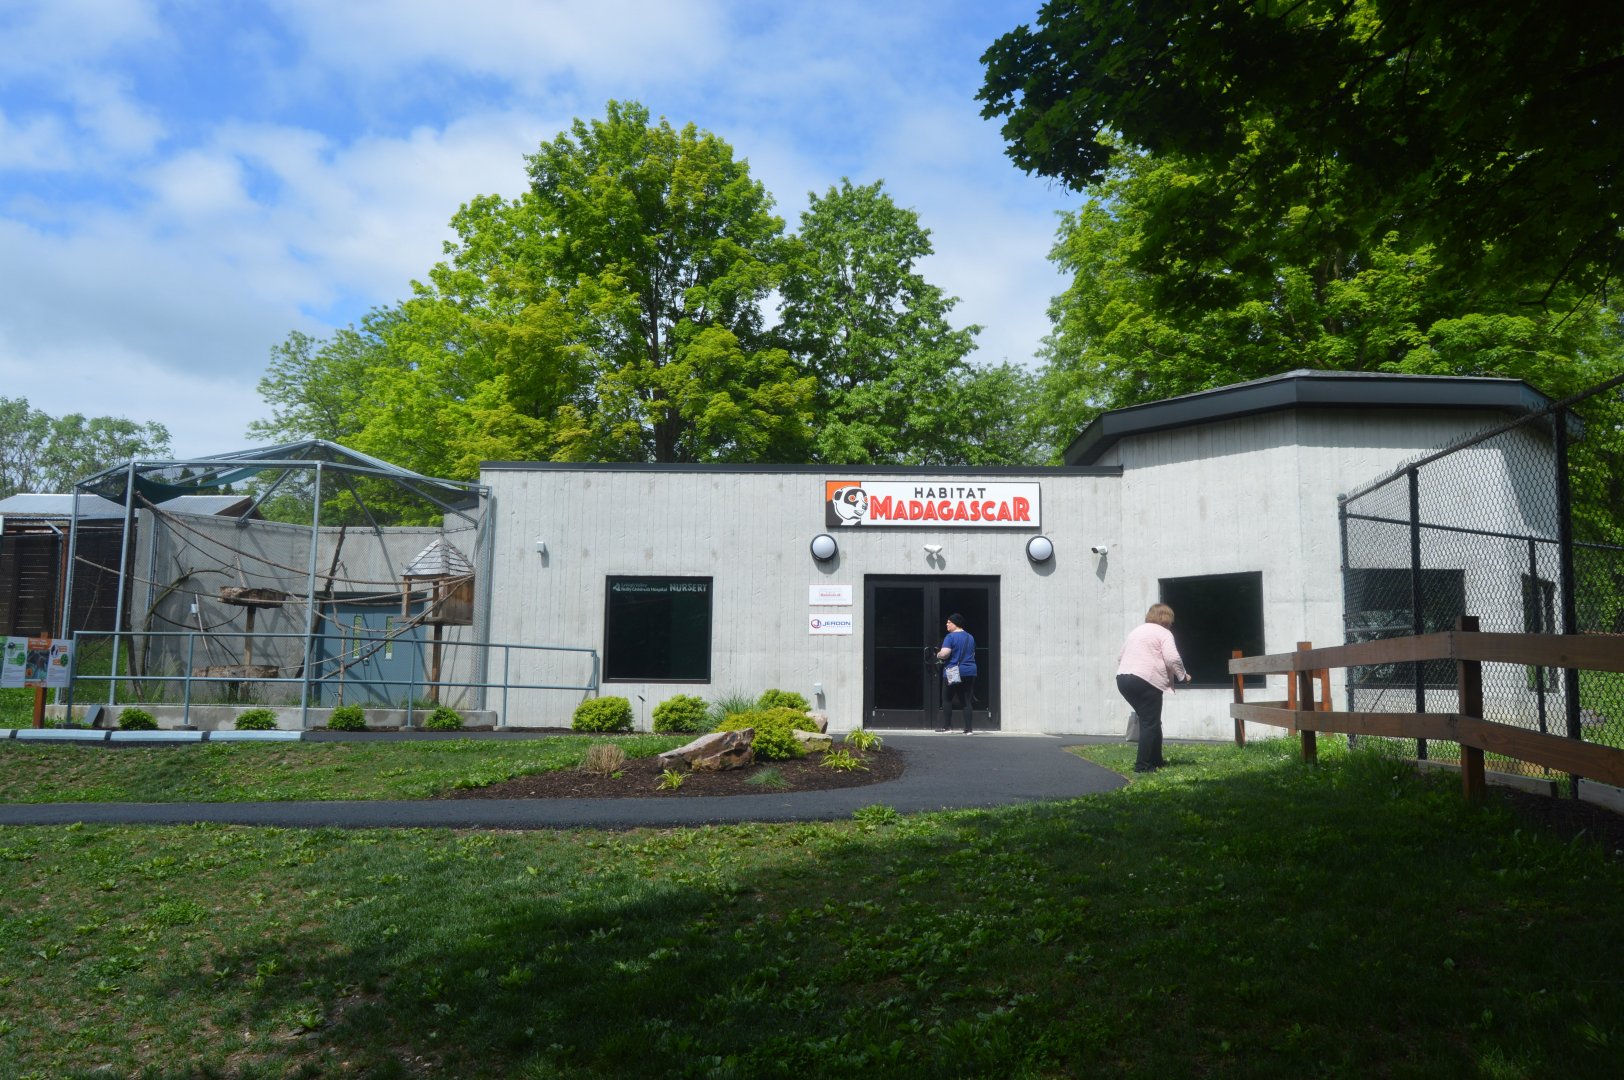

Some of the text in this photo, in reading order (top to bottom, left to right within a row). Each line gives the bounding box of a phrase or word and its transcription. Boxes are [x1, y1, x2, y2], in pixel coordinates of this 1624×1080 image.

[914, 487, 986, 499] HABITAT
[870, 495, 1031, 522] MADAGASCAR
[669, 583, 708, 592] NURSERY
